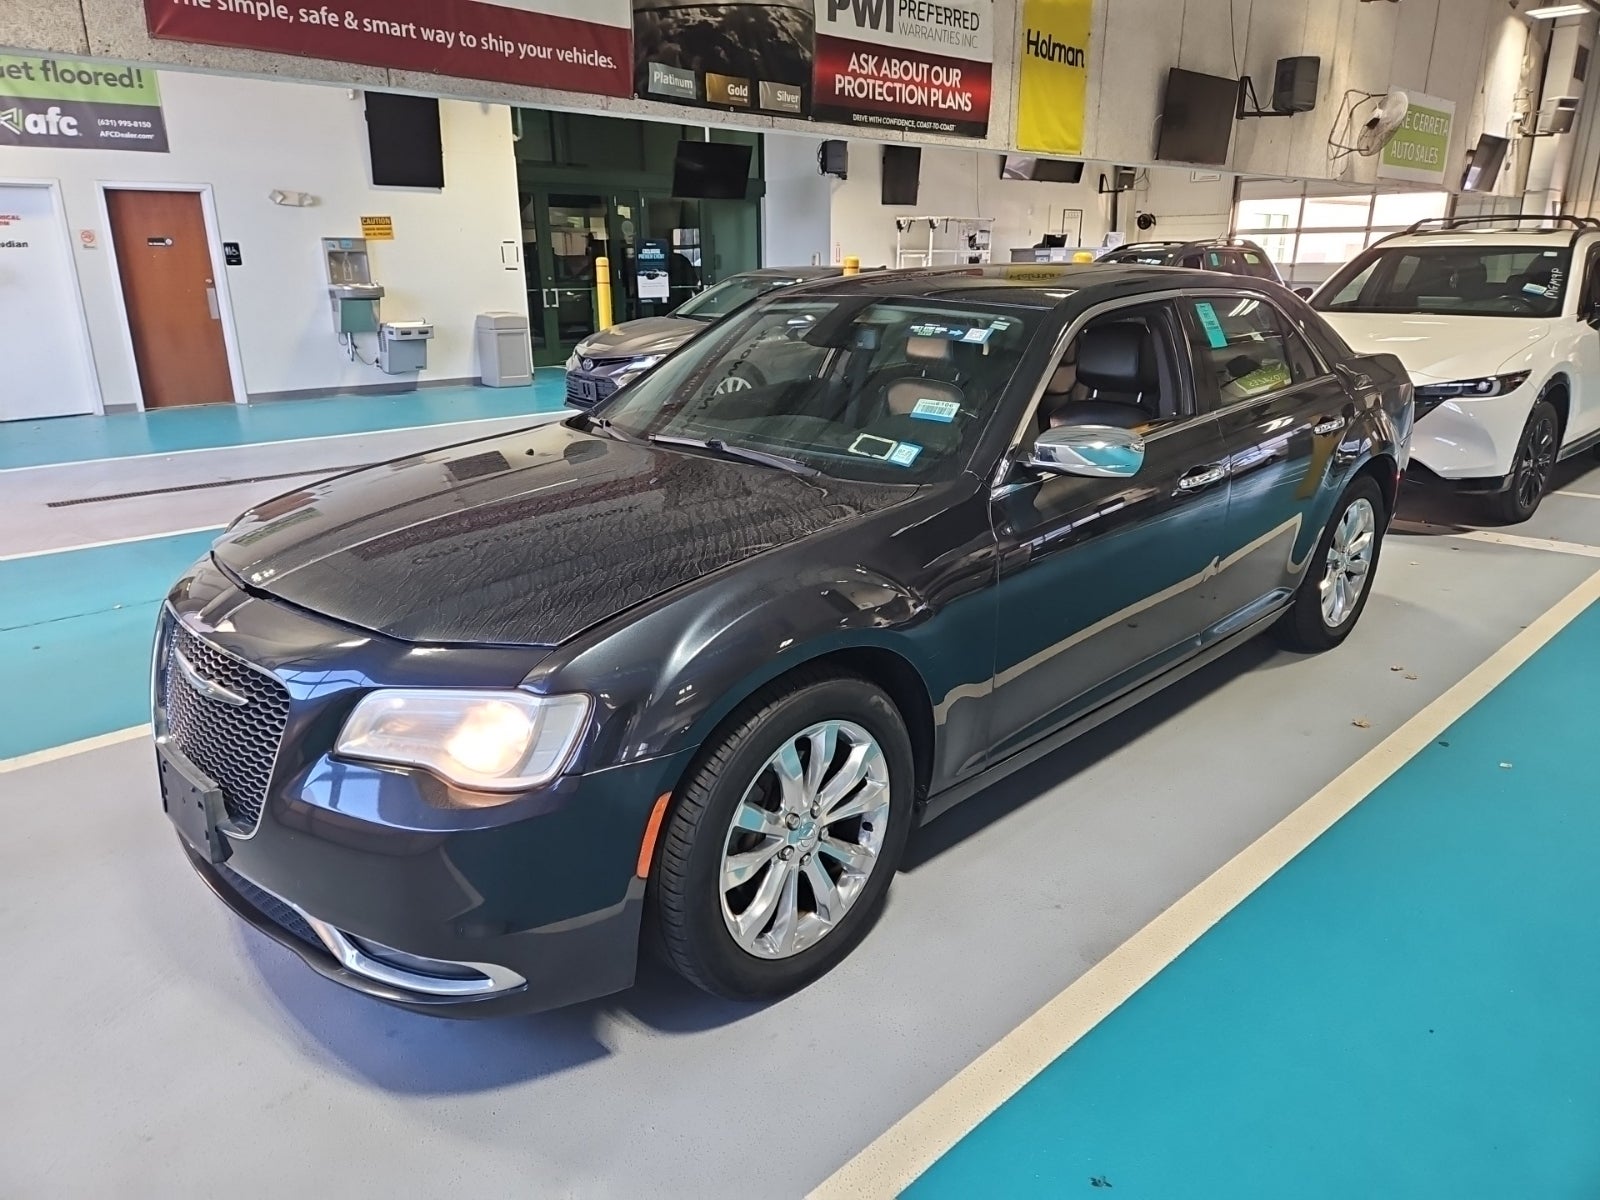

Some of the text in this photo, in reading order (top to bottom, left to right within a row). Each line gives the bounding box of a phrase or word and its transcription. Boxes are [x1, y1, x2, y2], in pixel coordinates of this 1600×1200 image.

[827, 0, 895, 33] PWI
[899, 0, 980, 31] PREFERRED
[217, 0, 617, 69] simple, safe & smart way to ship your vehicles.
[899, 22, 978, 49] WARRANTIES INC
[1026, 28, 1085, 69] Holman
[0, 59, 145, 89] et floored!
[653, 70, 694, 90] Platinum
[847, 51, 962, 88] ASK ABOUT OUR
[727, 83, 749, 98] Gold
[776, 90, 800, 103] Silver
[834, 73, 972, 112] PROTECTION PLANS
[24, 106, 79, 137] afc
[97, 118, 118, 128] (631)
[852, 113, 869, 123] DRIVE
[868, 115, 882, 125] WITH
[882, 117, 917, 129] CONFIDENCE,
[1412, 112, 1450, 137] CERRETA
[1390, 140, 1439, 165] AUTO SALES
[362, 217, 391, 225] CAUTION
